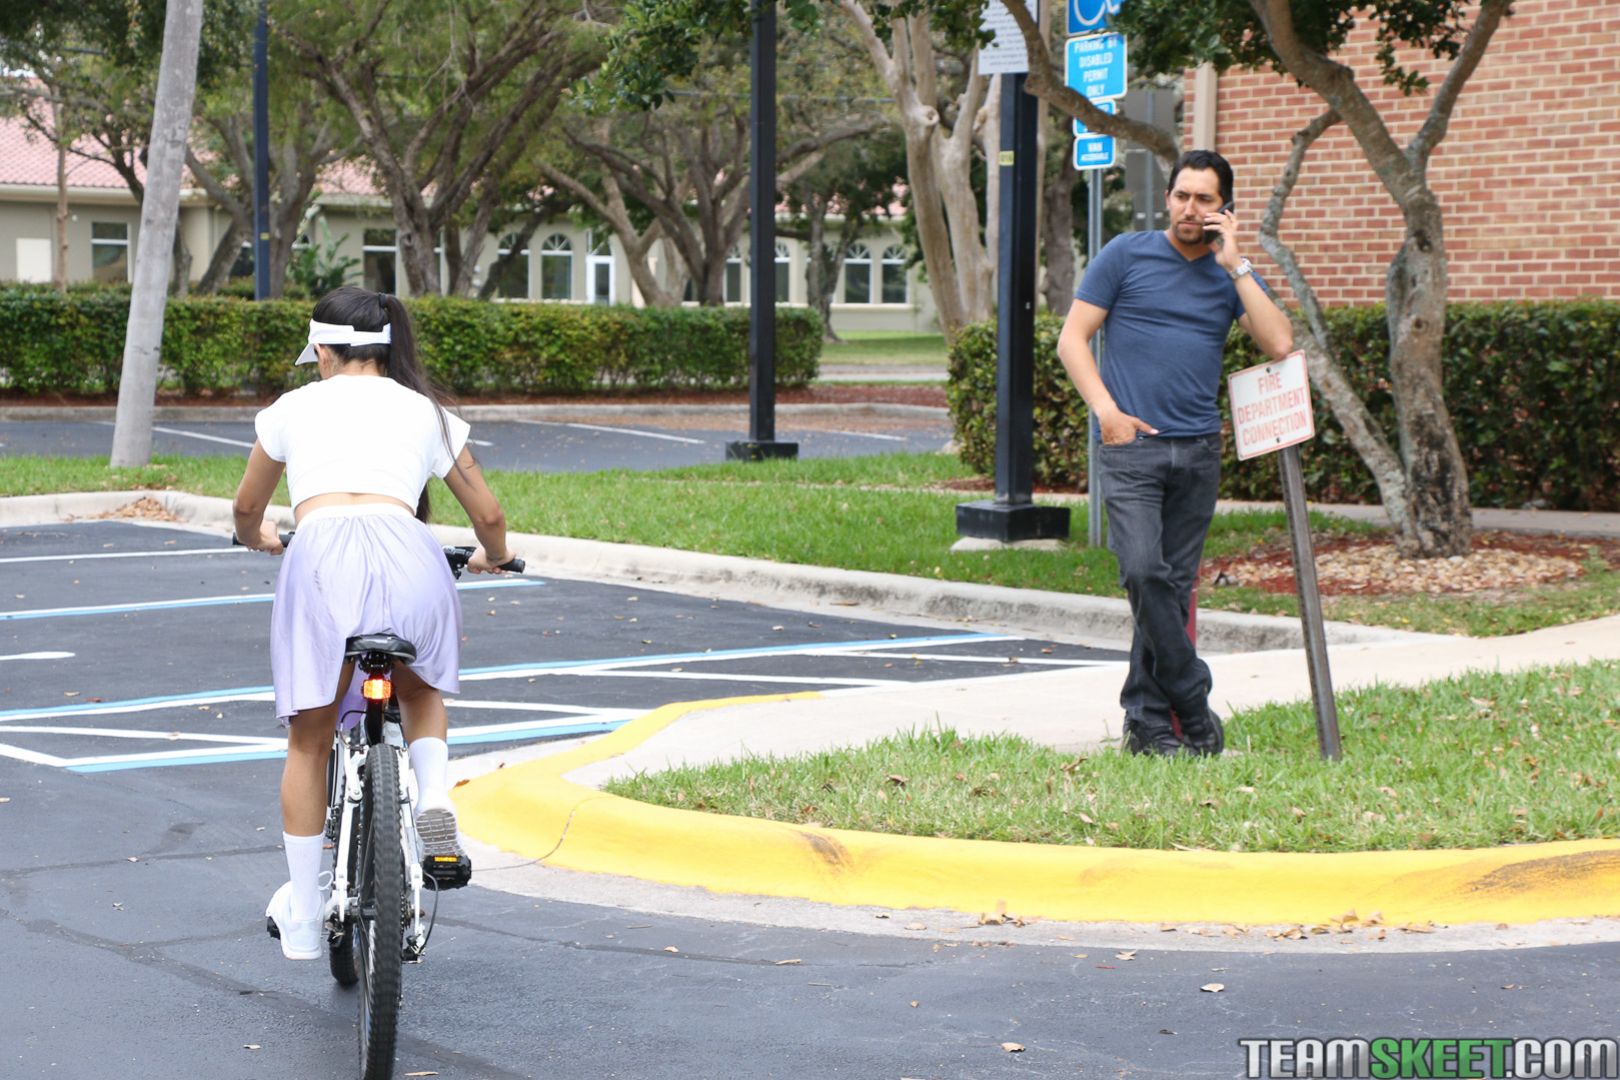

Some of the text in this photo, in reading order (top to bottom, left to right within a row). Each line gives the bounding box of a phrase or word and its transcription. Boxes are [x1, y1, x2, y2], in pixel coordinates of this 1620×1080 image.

[1079, 52, 1113, 68] DISABLED
[1083, 67, 1108, 82] PERMIT
[1086, 84, 1105, 97] ONLY
[1258, 371, 1282, 395] FIRE
[1237, 388, 1305, 424] DEPARTMENT
[1242, 410, 1306, 445] CONNECTION
